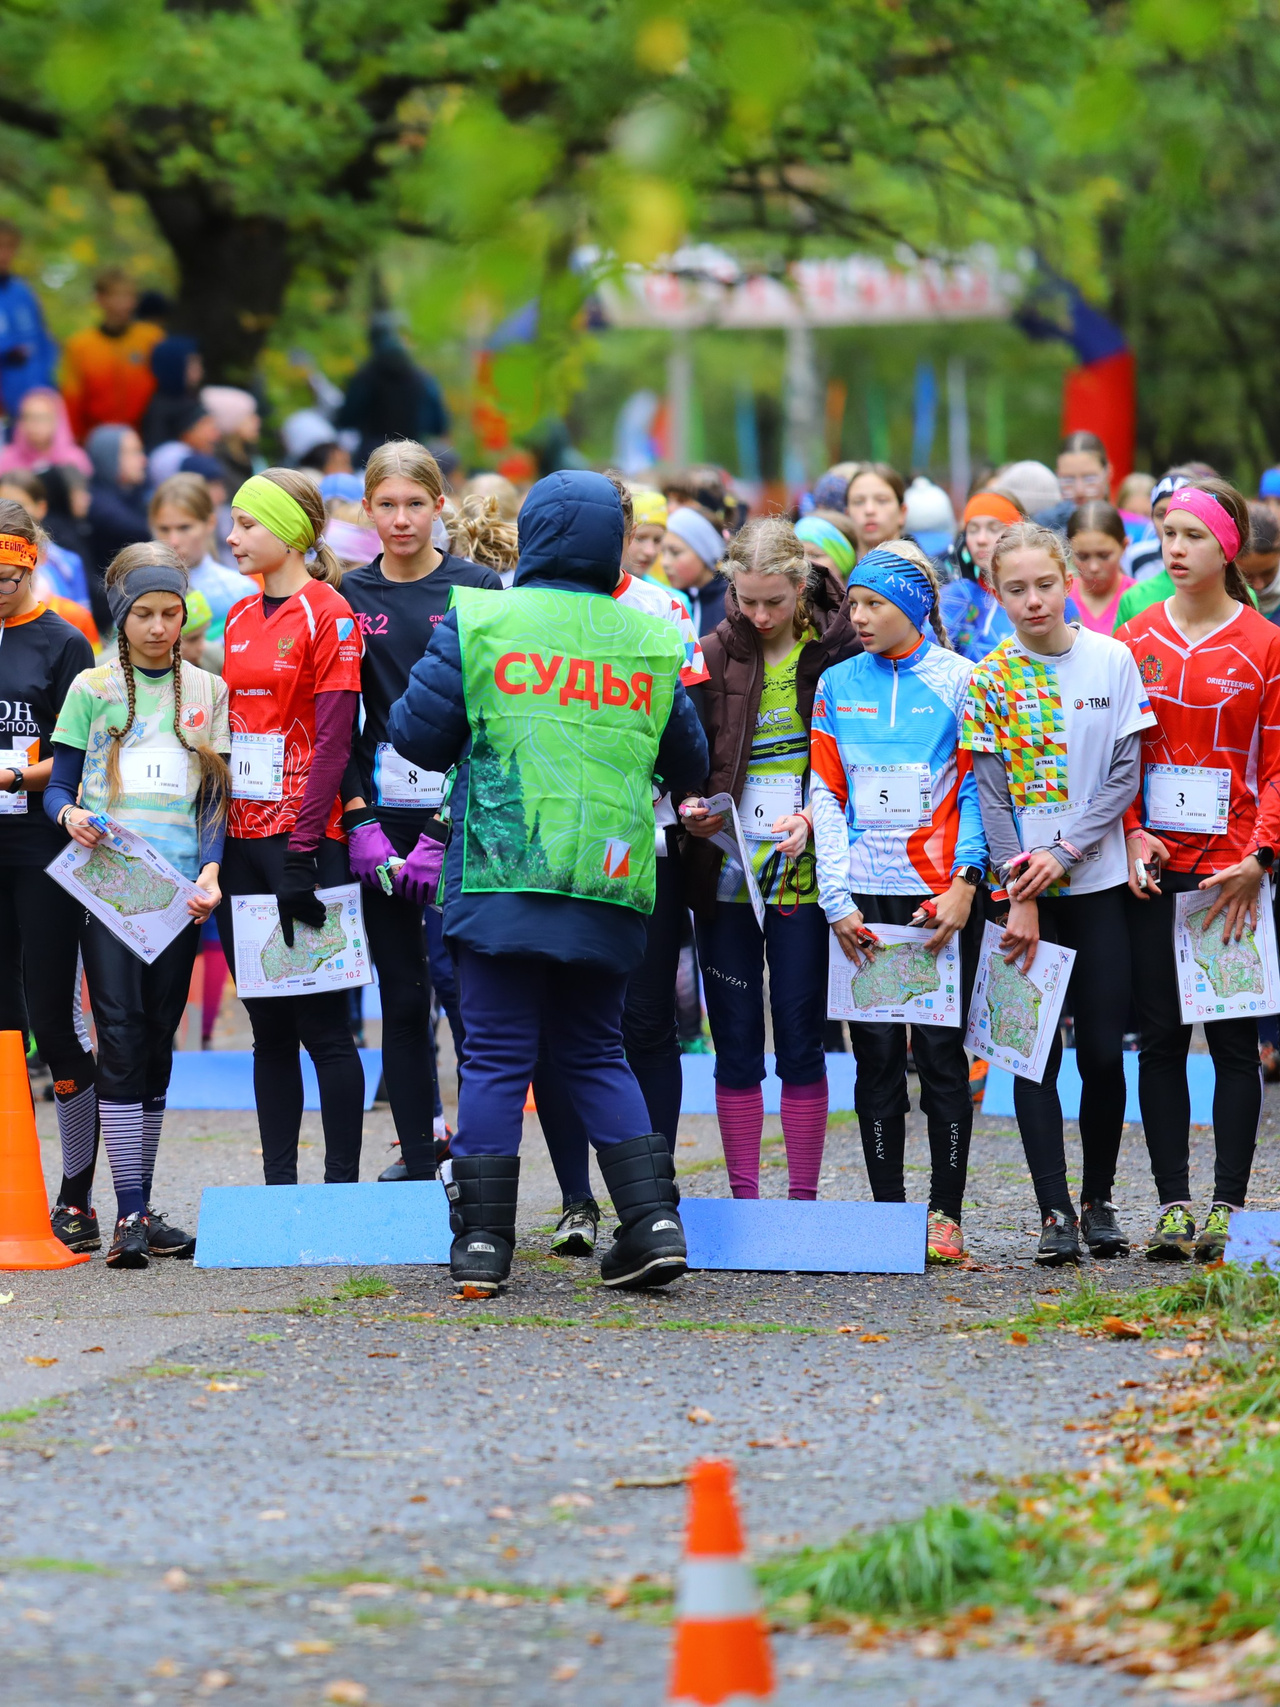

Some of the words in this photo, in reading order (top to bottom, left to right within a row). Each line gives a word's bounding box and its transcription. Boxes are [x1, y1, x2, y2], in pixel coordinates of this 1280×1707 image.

[494, 652, 653, 716] СУДЬЯ
[1206, 677, 1255, 690] ORIENTEERING
[1220, 686, 1239, 695] TEAM
[911, 705, 934, 714] ars
[147, 764, 161, 778] 11
[238, 761, 250, 775] 10
[408, 770, 418, 784] 8
[879, 790, 889, 804] 5
[1176, 792, 1185, 807] 3
[754, 804, 764, 818] 6
[345, 970, 361, 979] 10.2
[1185, 993, 1193, 1005] 3.2
[932, 1013, 945, 1022] 5.2
